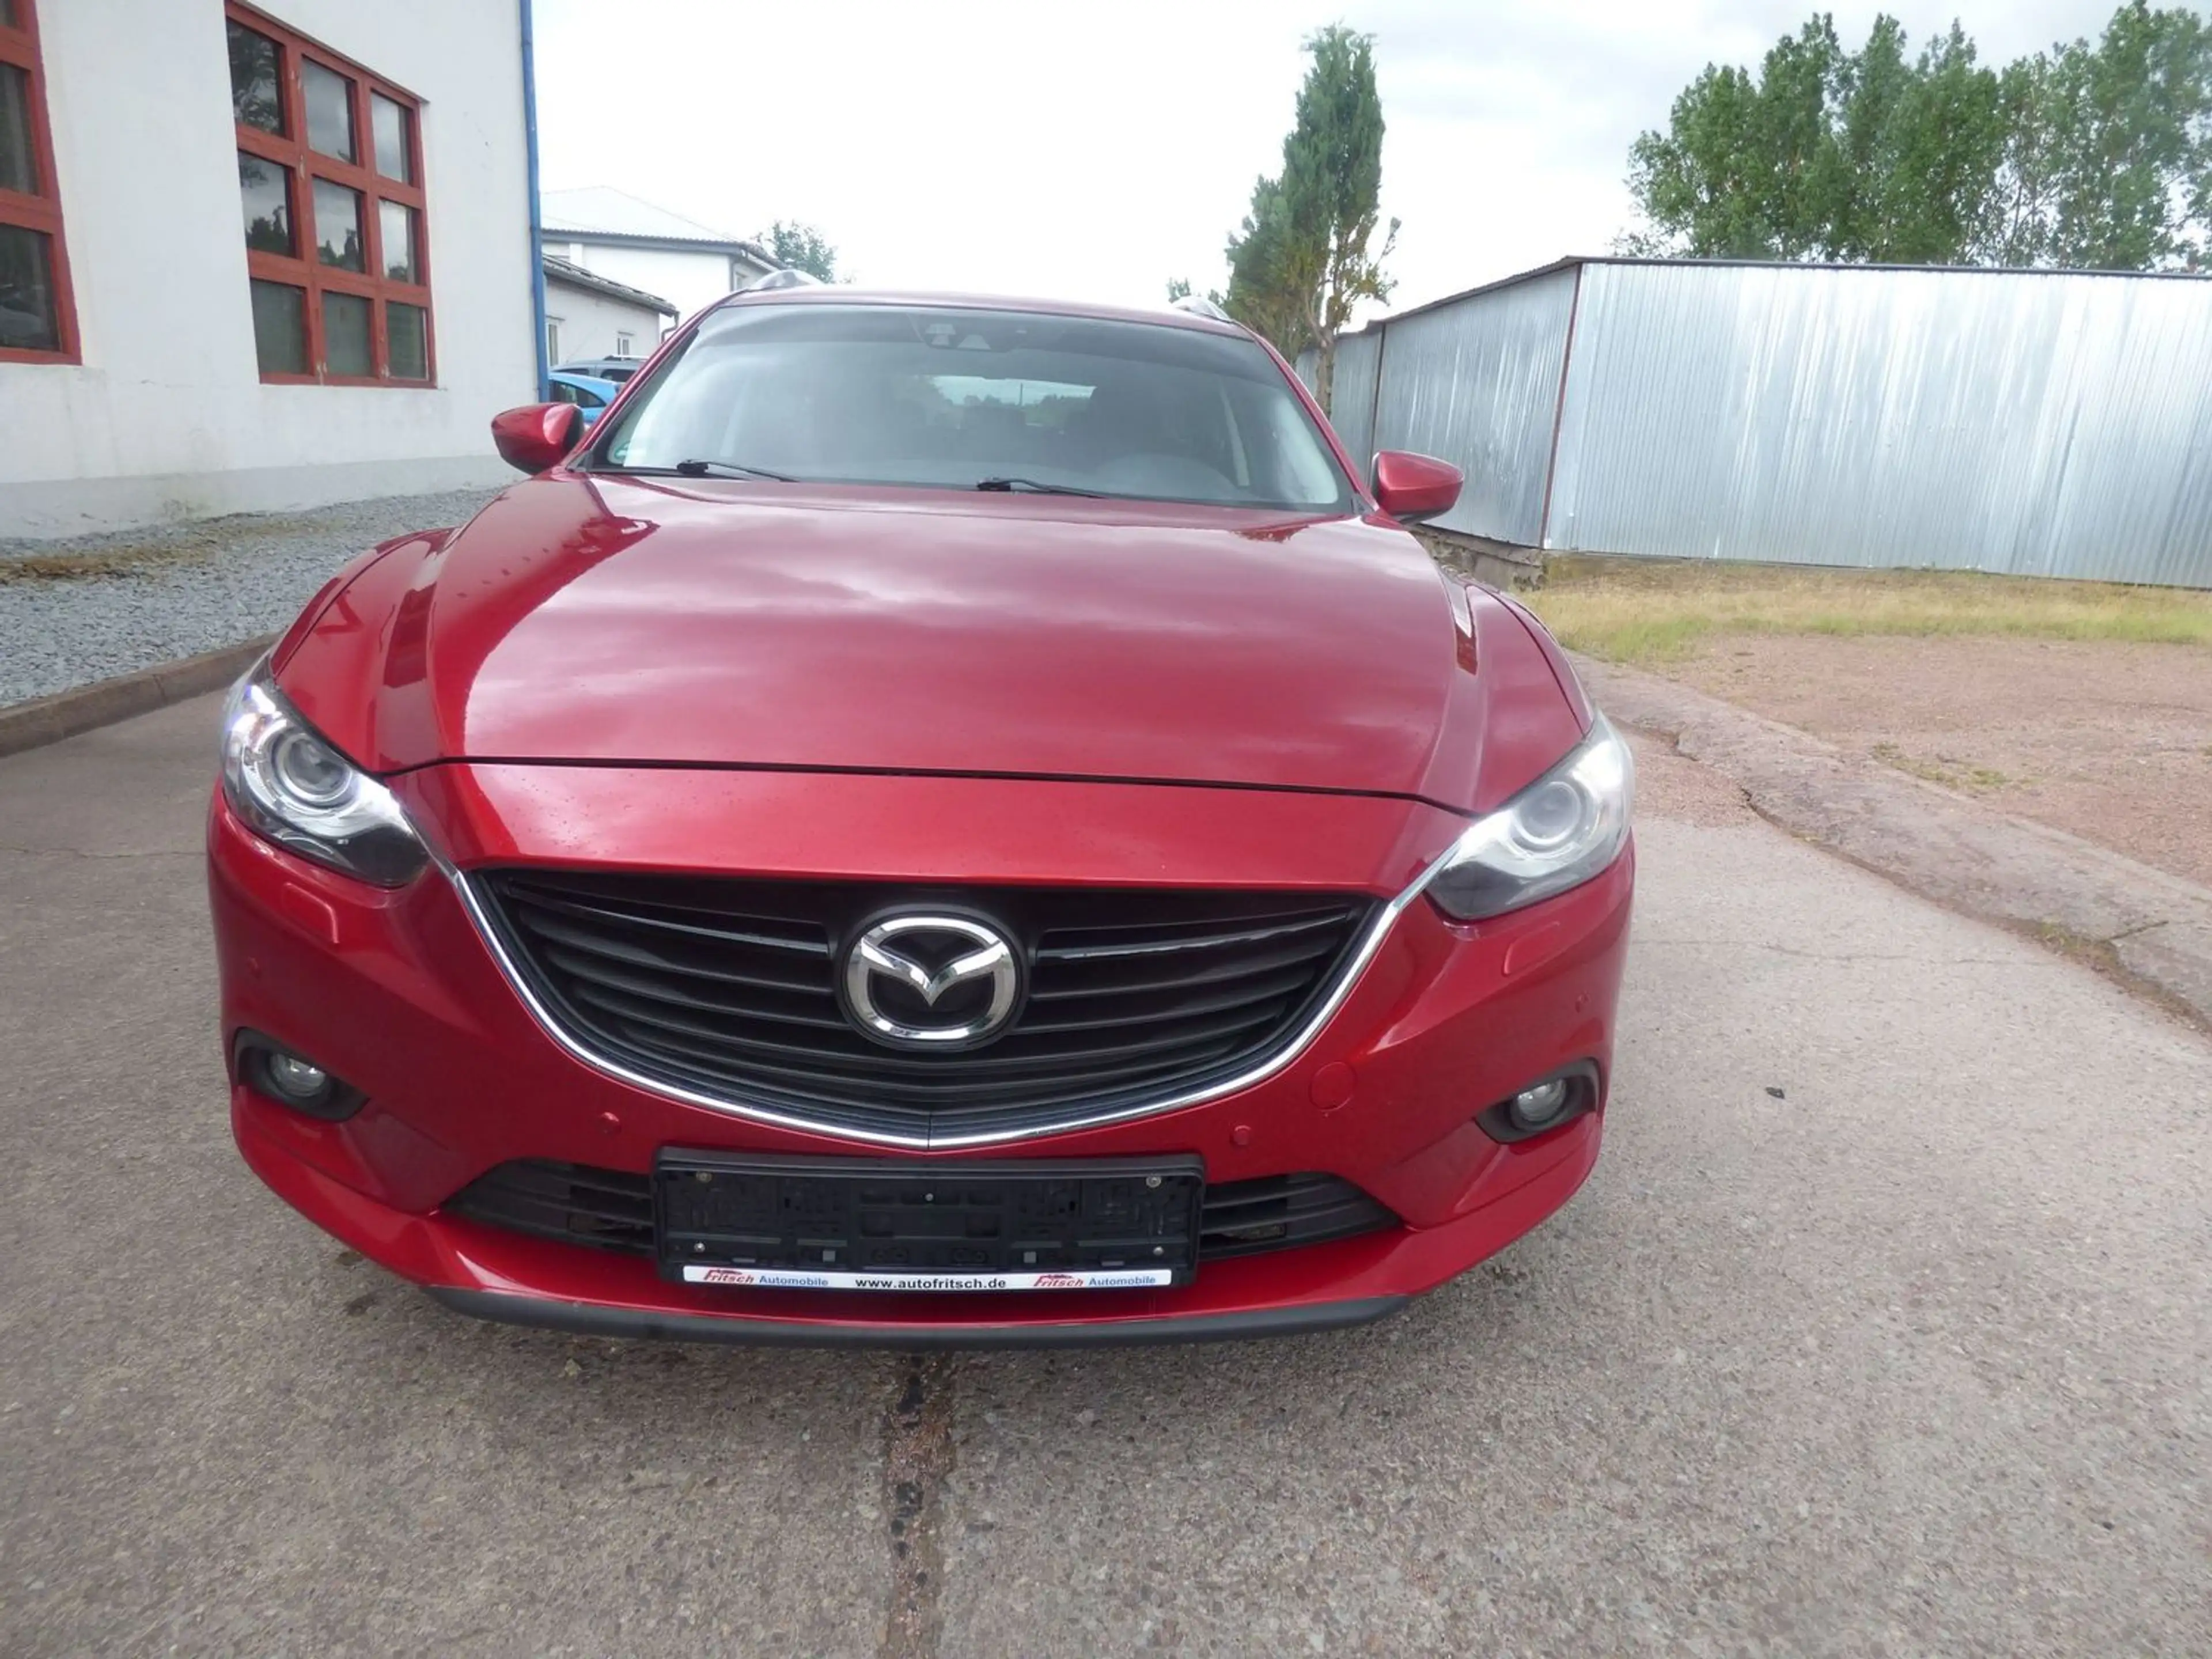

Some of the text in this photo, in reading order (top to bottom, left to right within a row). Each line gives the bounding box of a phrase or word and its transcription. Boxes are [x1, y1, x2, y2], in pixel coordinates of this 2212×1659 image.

[704, 1269, 828, 1286] Fritsch Automobile
[855, 1277, 1006, 1290] www.autofritsch.de
[1033, 1274, 1156, 1287] Fritsch Automobile
